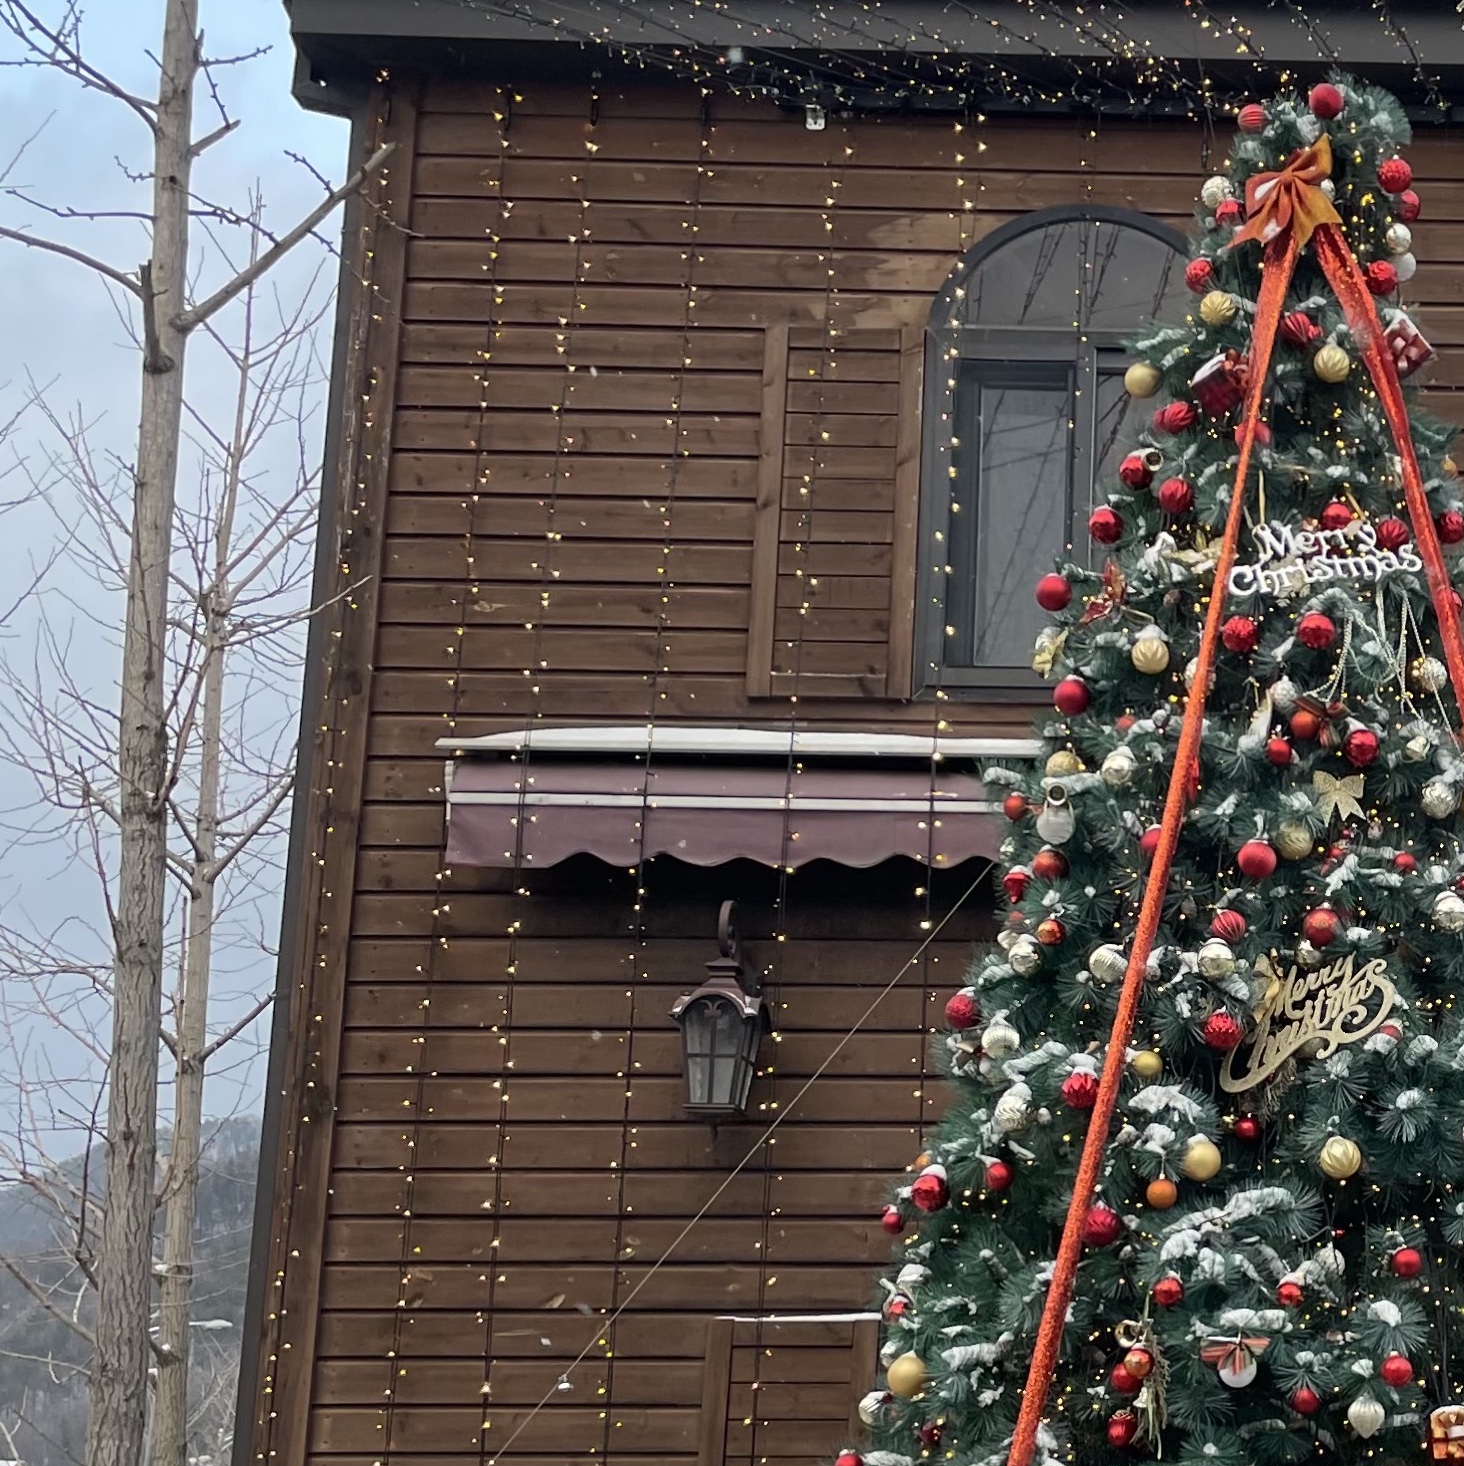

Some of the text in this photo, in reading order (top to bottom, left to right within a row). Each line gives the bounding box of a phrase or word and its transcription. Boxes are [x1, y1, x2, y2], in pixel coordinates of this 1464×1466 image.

[1252, 519, 1380, 562] Merry
[1228, 543, 1422, 596] Christmas
[1272, 951, 1356, 1020] Merry
